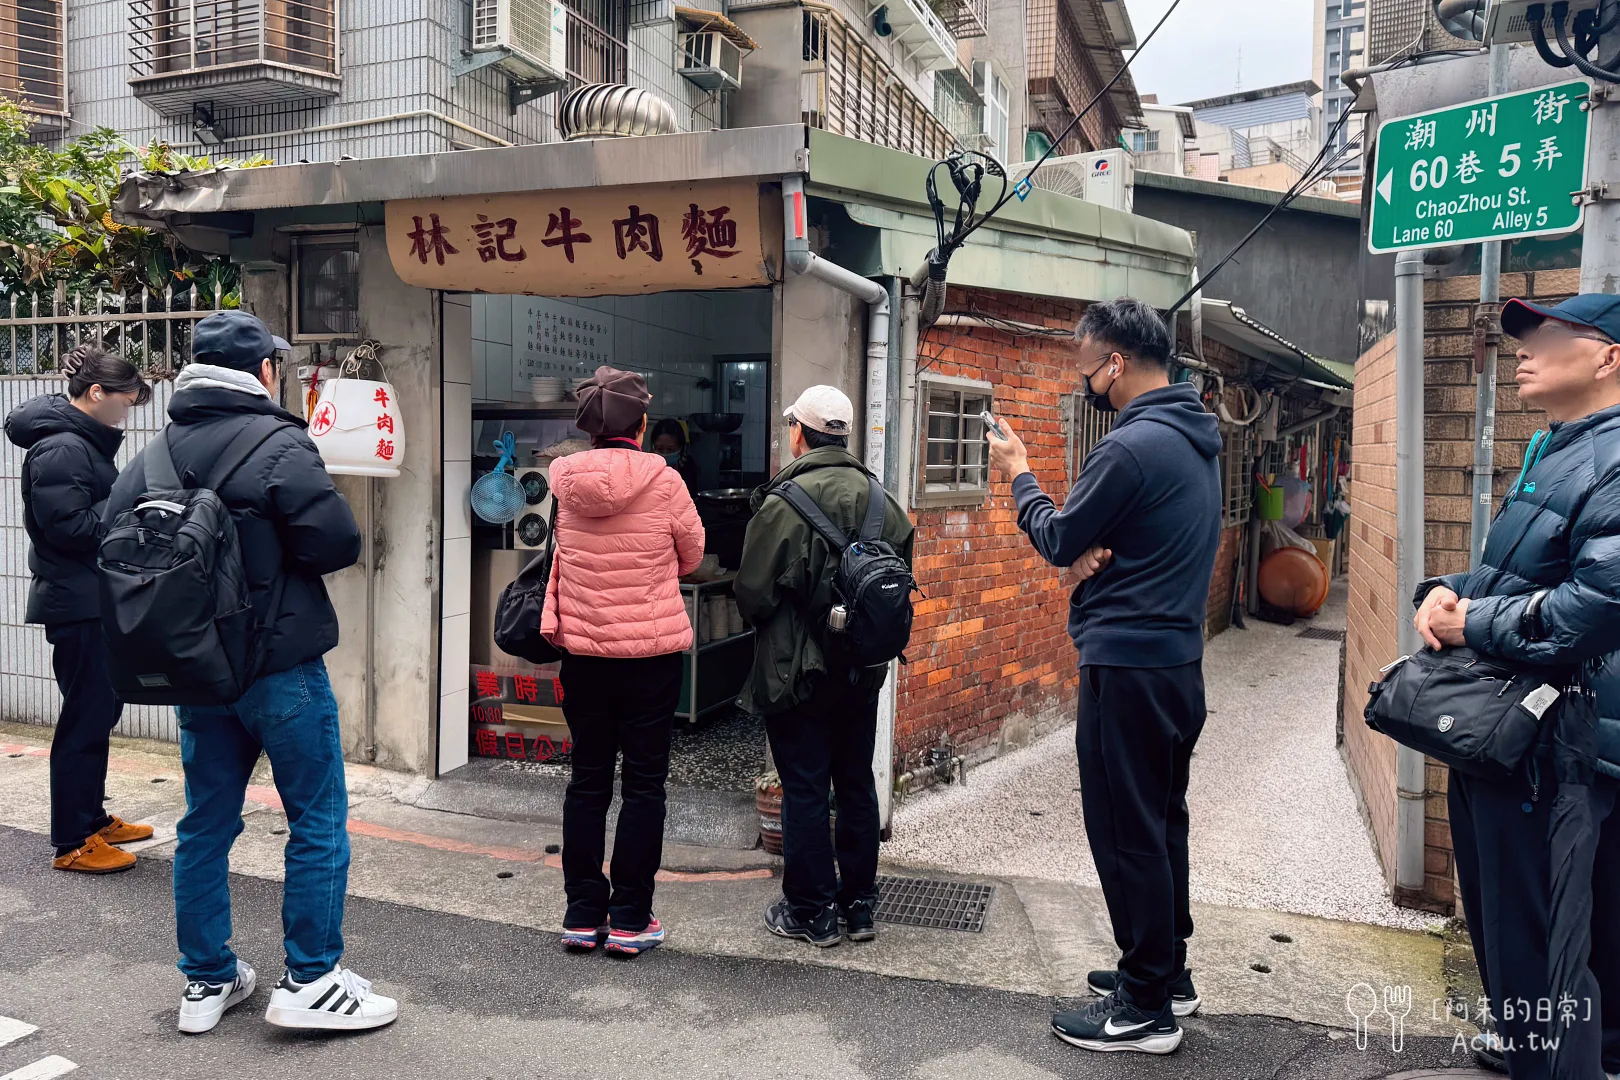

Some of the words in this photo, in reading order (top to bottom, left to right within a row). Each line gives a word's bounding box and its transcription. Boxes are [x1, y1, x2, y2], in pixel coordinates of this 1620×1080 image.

[1404, 91, 1570, 151] 潮州街
[1091, 170, 1111, 178] GREE
[1409, 135, 1563, 192] 60巷5弄
[1392, 225, 1430, 243] Lane
[1434, 219, 1454, 239] 60
[1492, 212, 1532, 231] Alley
[1536, 206, 1548, 226] 5
[1415, 193, 1501, 219] ChaoZhou
[1507, 186, 1531, 207] St.
[406, 203, 743, 266] 林記牛肉麵
[373, 387, 394, 461] 牛肉麵
[471, 705, 502, 724] 10:30
